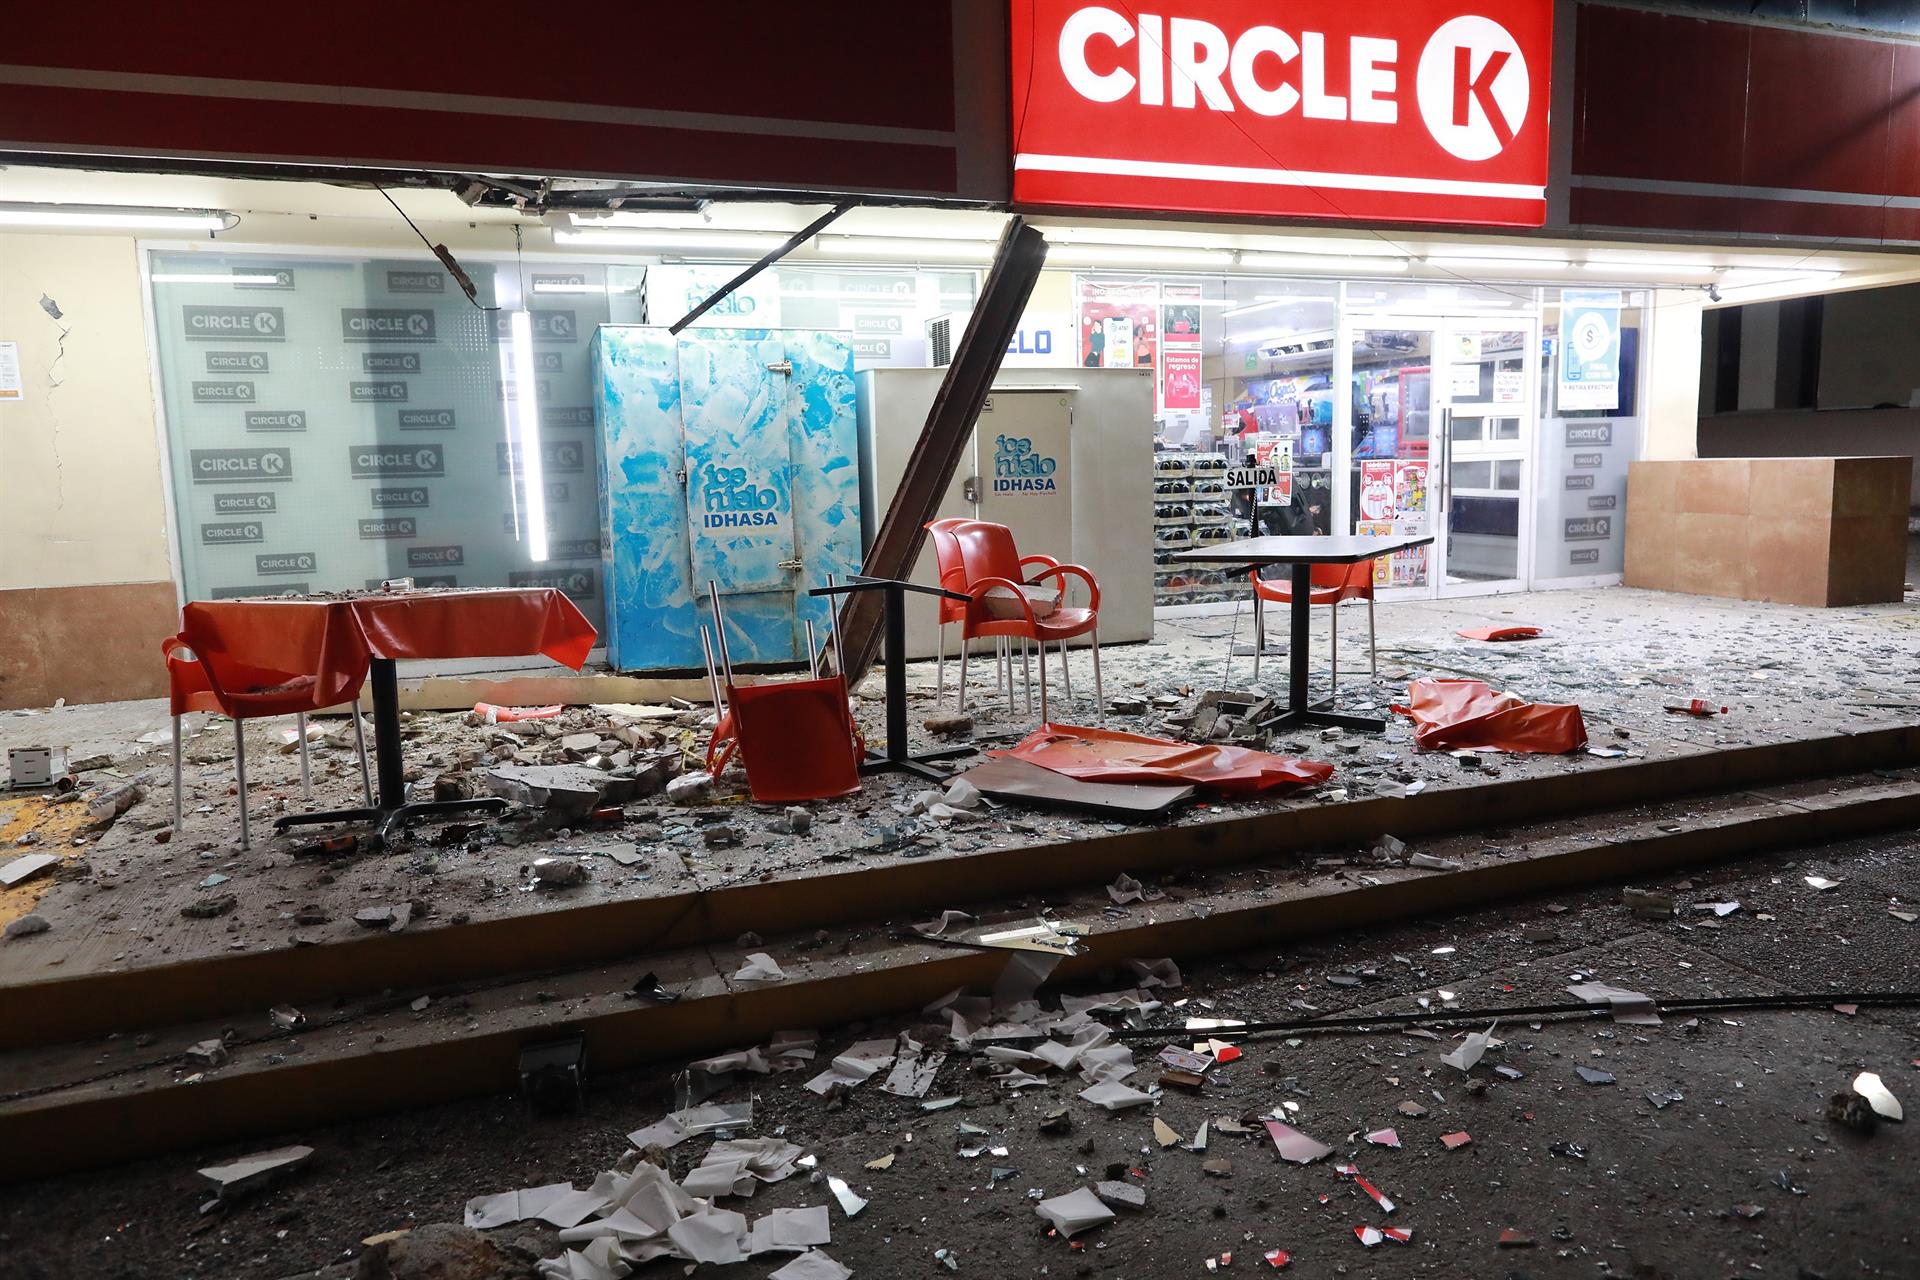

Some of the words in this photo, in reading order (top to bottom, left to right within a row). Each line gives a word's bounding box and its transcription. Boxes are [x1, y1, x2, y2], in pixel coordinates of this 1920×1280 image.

[1058, 6, 1398, 124] CIRCLE
[391, 276, 424, 286] CIRCLE
[191, 315, 250, 328] CIRCLE
[350, 318, 404, 330] CIRCLE
[858, 320, 887, 328] CIRCLE
[211, 357, 248, 366] CIRCLE
[367, 358, 400, 366] CIRCLE
[198, 387, 234, 396] CIRCLE
[354, 387, 388, 395] CIRCLE
[250, 416, 286, 424] CIRCLE
[402, 415, 436, 424] CIRCLE
[1569, 430, 1597, 438] CIRCLE
[995, 434, 1032, 457] ice
[200, 458, 258, 471] CIRCLE
[358, 454, 412, 466] CIRCLE
[704, 464, 746, 488] ice
[1227, 470, 1277, 486] SALIDA
[994, 478, 1056, 492] IDHASA
[376, 492, 410, 502] CIRCLE
[704, 484, 776, 512] hielo
[219, 499, 255, 508] CIRCLE
[704, 512, 778, 528] IDHASA
[364, 524, 397, 532] CIRCLE
[1568, 524, 1596, 533] CIRCLE
[206, 529, 242, 538] CIRCLE
[412, 553, 444, 561] CIRCLE
[261, 560, 296, 568] CIRCLE
